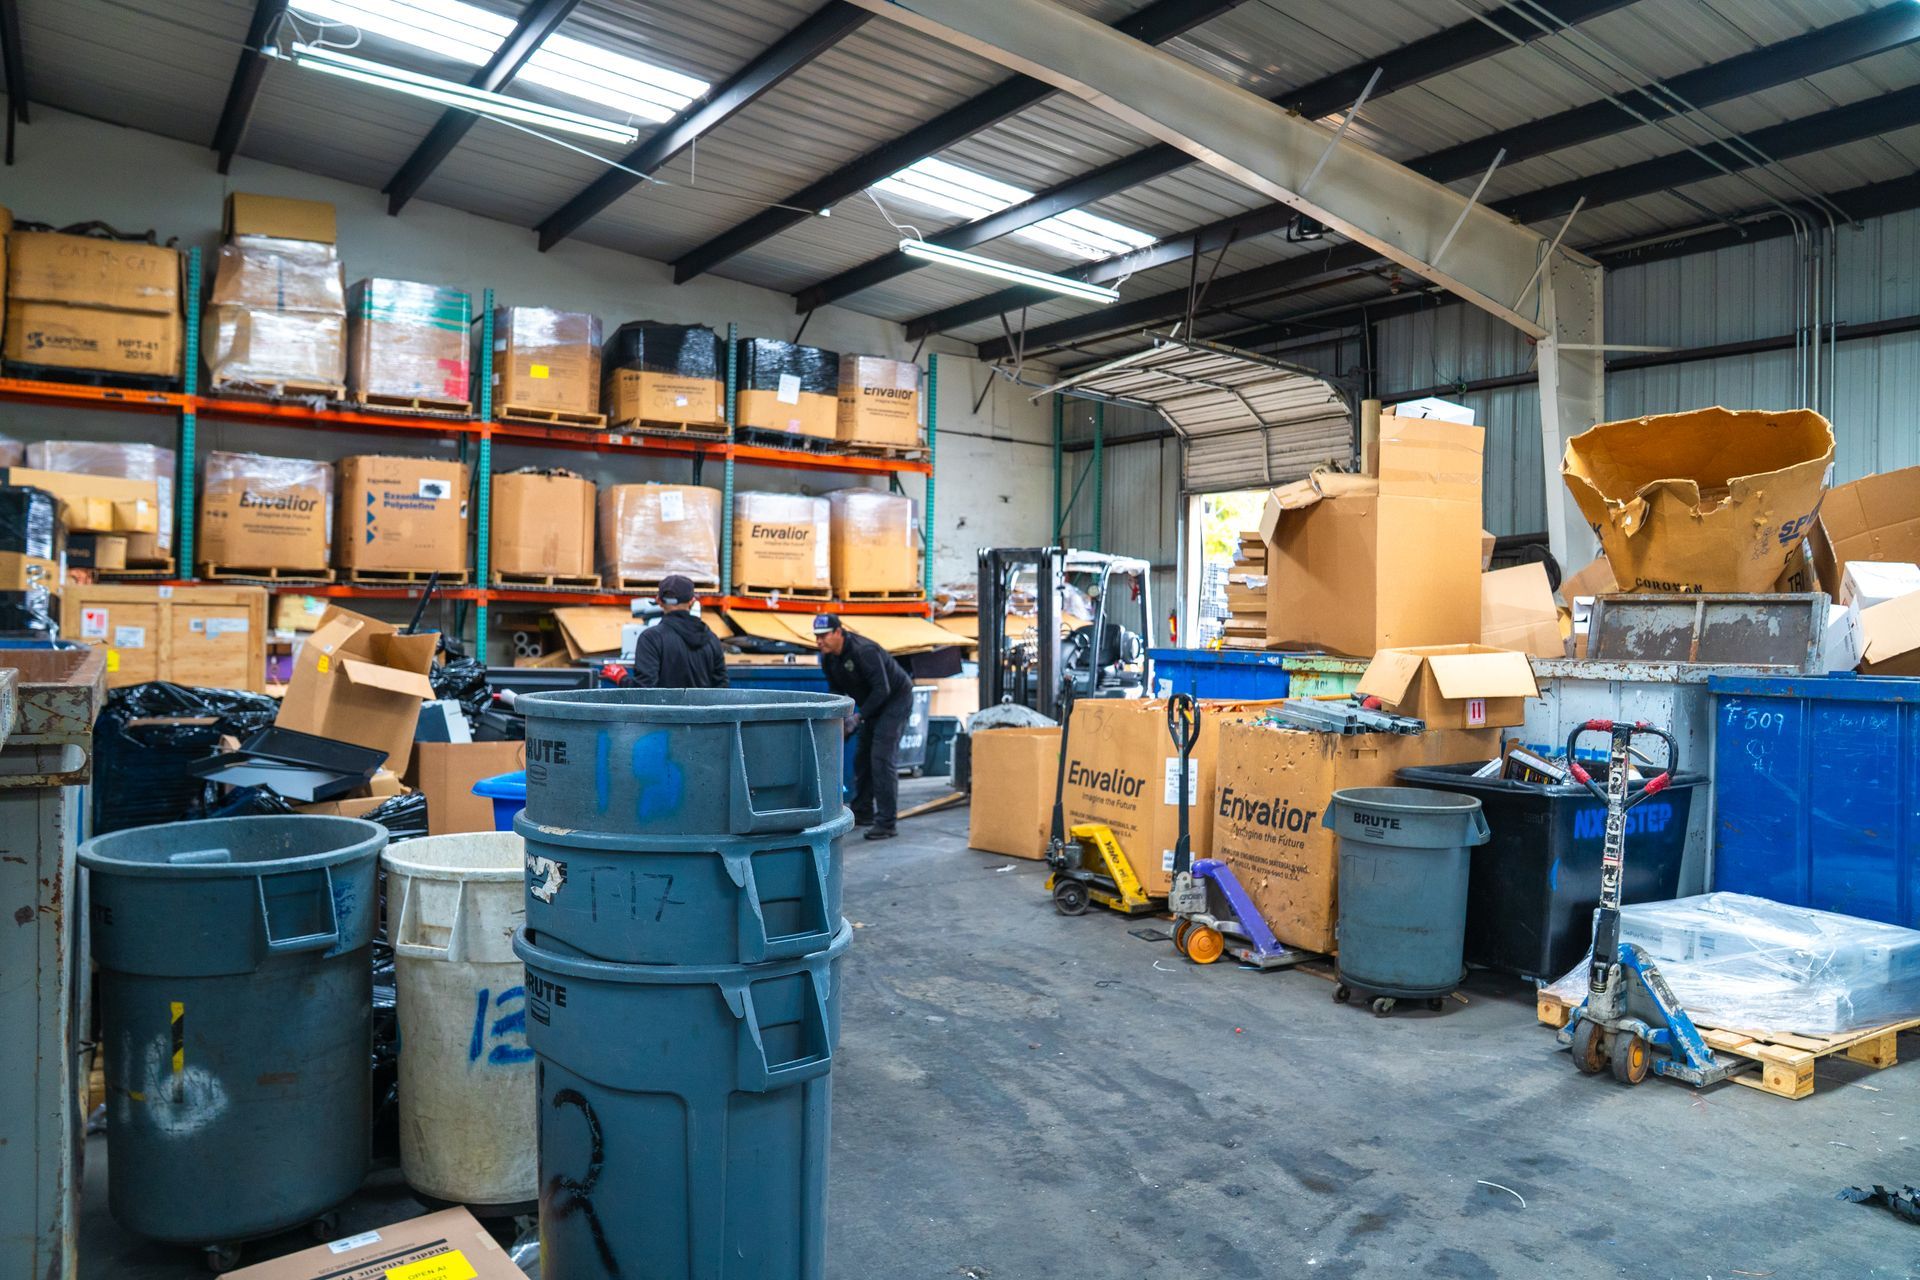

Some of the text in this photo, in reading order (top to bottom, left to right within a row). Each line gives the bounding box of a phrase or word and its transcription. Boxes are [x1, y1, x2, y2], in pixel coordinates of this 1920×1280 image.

[239, 491, 318, 512] Envalior
[383, 491, 437, 502] ExxonM
[751, 524, 810, 541] Envalior
[1068, 760, 1146, 798] Envalior
[1082, 792, 1137, 811] Imagine the Future
[1219, 787, 1318, 834] Envalior
[1353, 812, 1401, 830] BRUTE
[1264, 833, 1277, 844] the
[1278, 834, 1305, 849] Future
